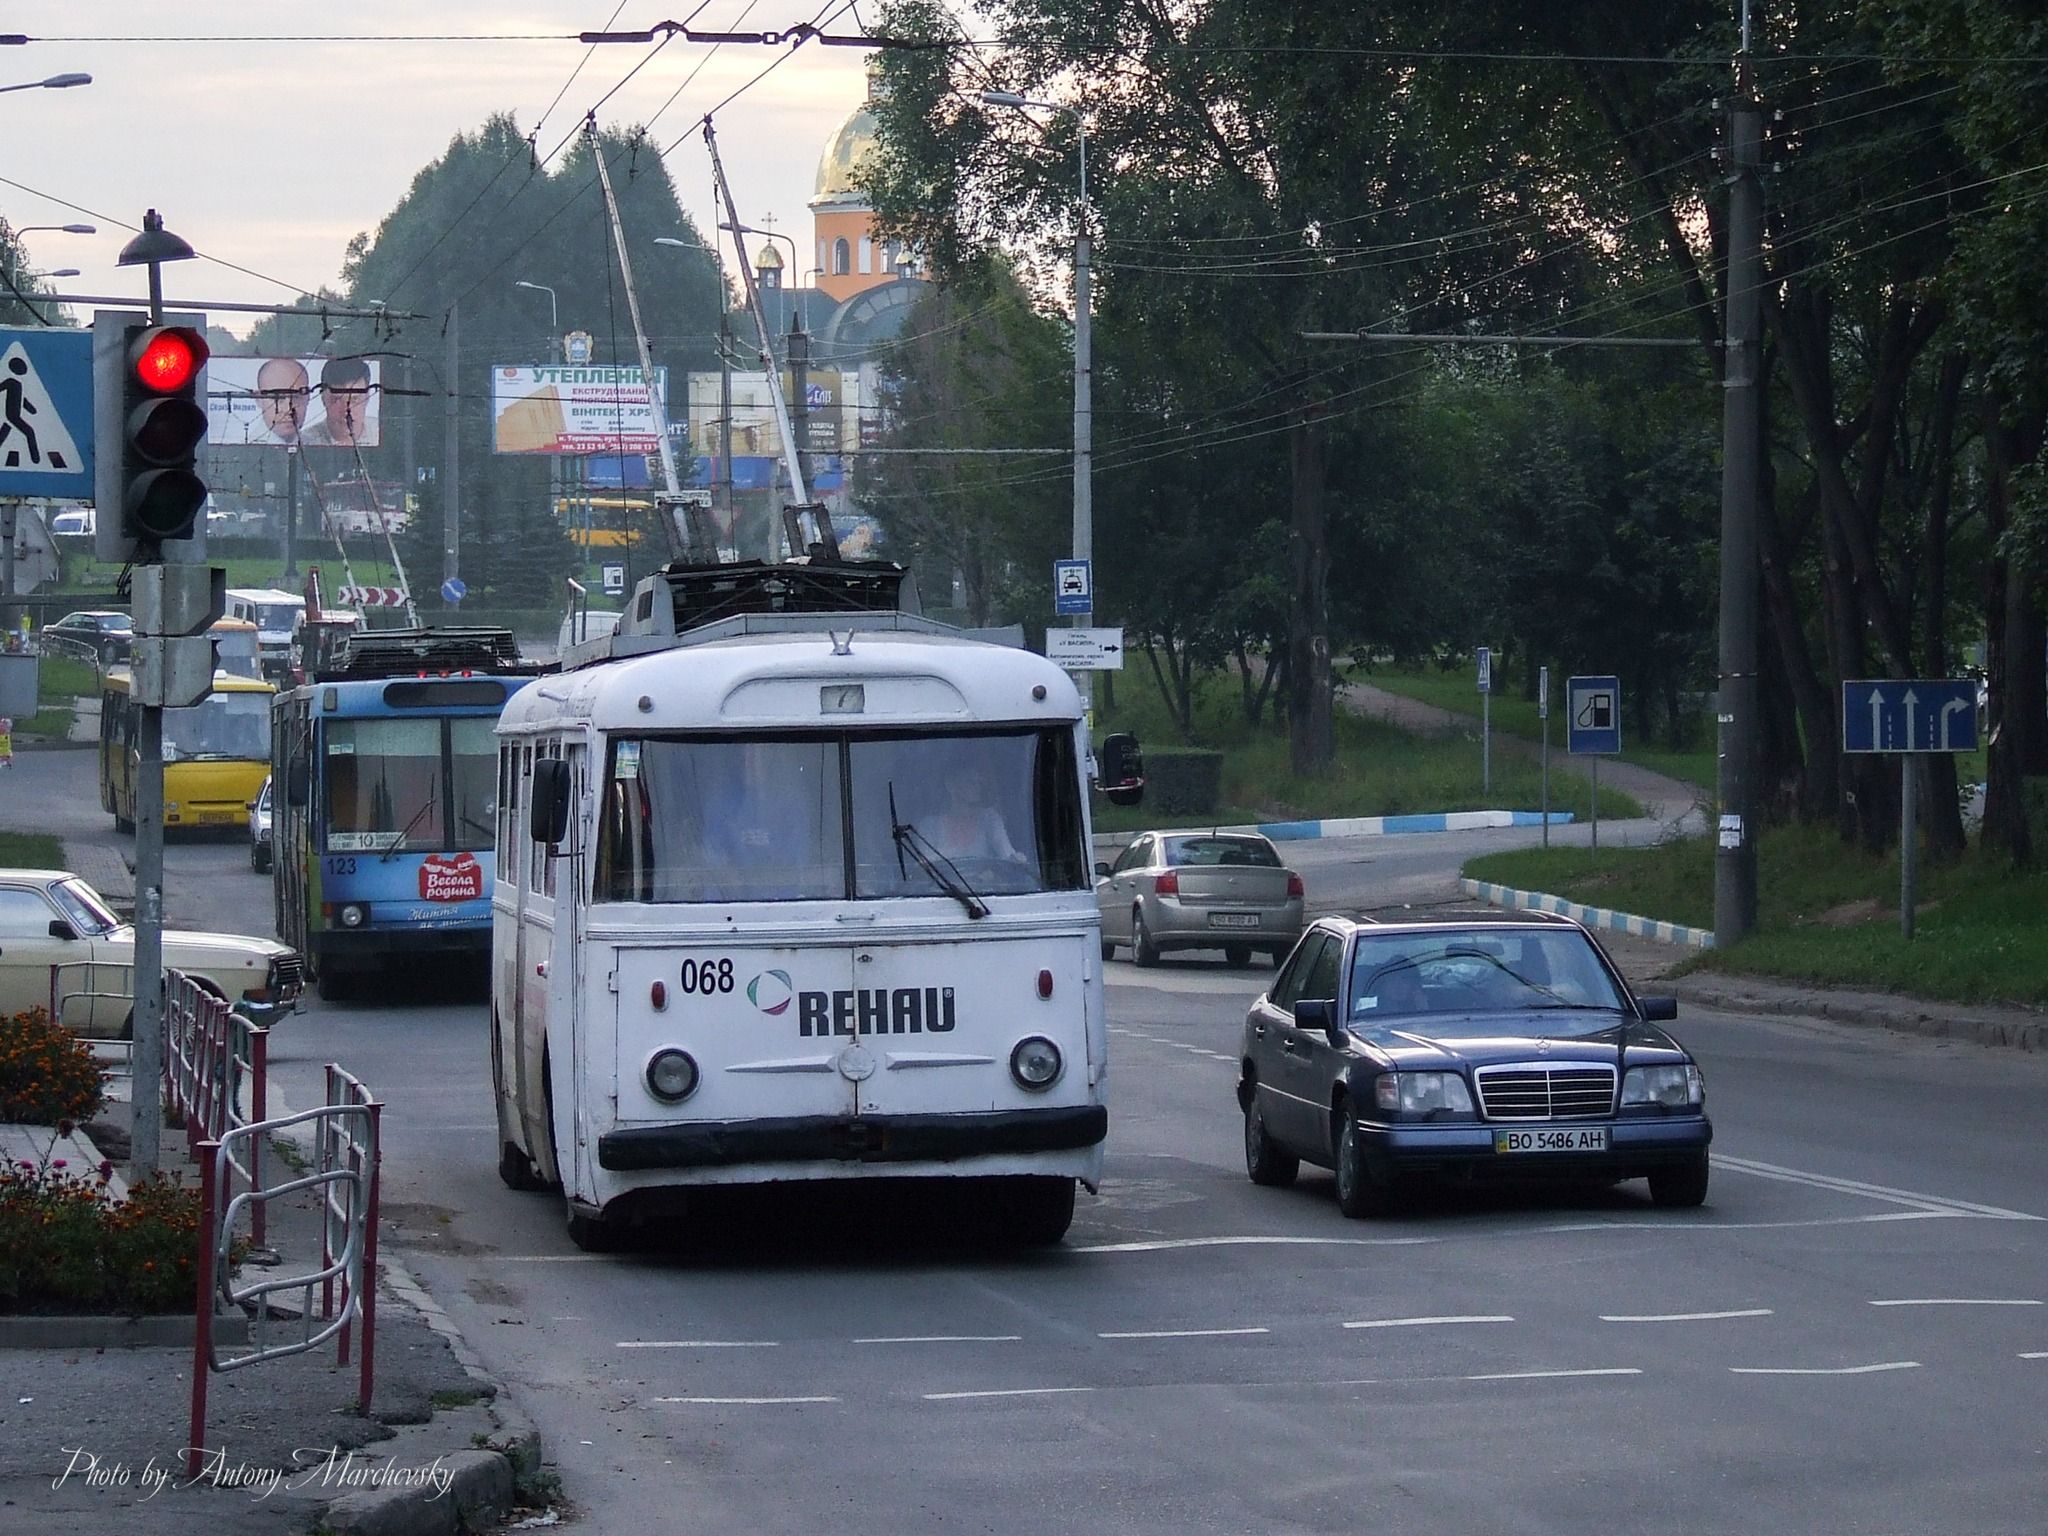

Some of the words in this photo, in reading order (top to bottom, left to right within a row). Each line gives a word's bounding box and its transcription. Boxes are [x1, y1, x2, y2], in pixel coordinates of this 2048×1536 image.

[572, 408, 624, 417] ВІНІТЕКС
[628, 408, 651, 417] XPS
[667, 423, 689, 435] НТ?
[358, 833, 374, 848] 10
[328, 858, 357, 875] 123
[427, 873, 474, 888] Весела
[426, 886, 475, 899] родина
[681, 958, 735, 995] 068
[1508, 1133, 1532, 1150] BO
[1537, 1132, 1574, 1149] 5486
[1578, 1131, 1602, 1148] AH
